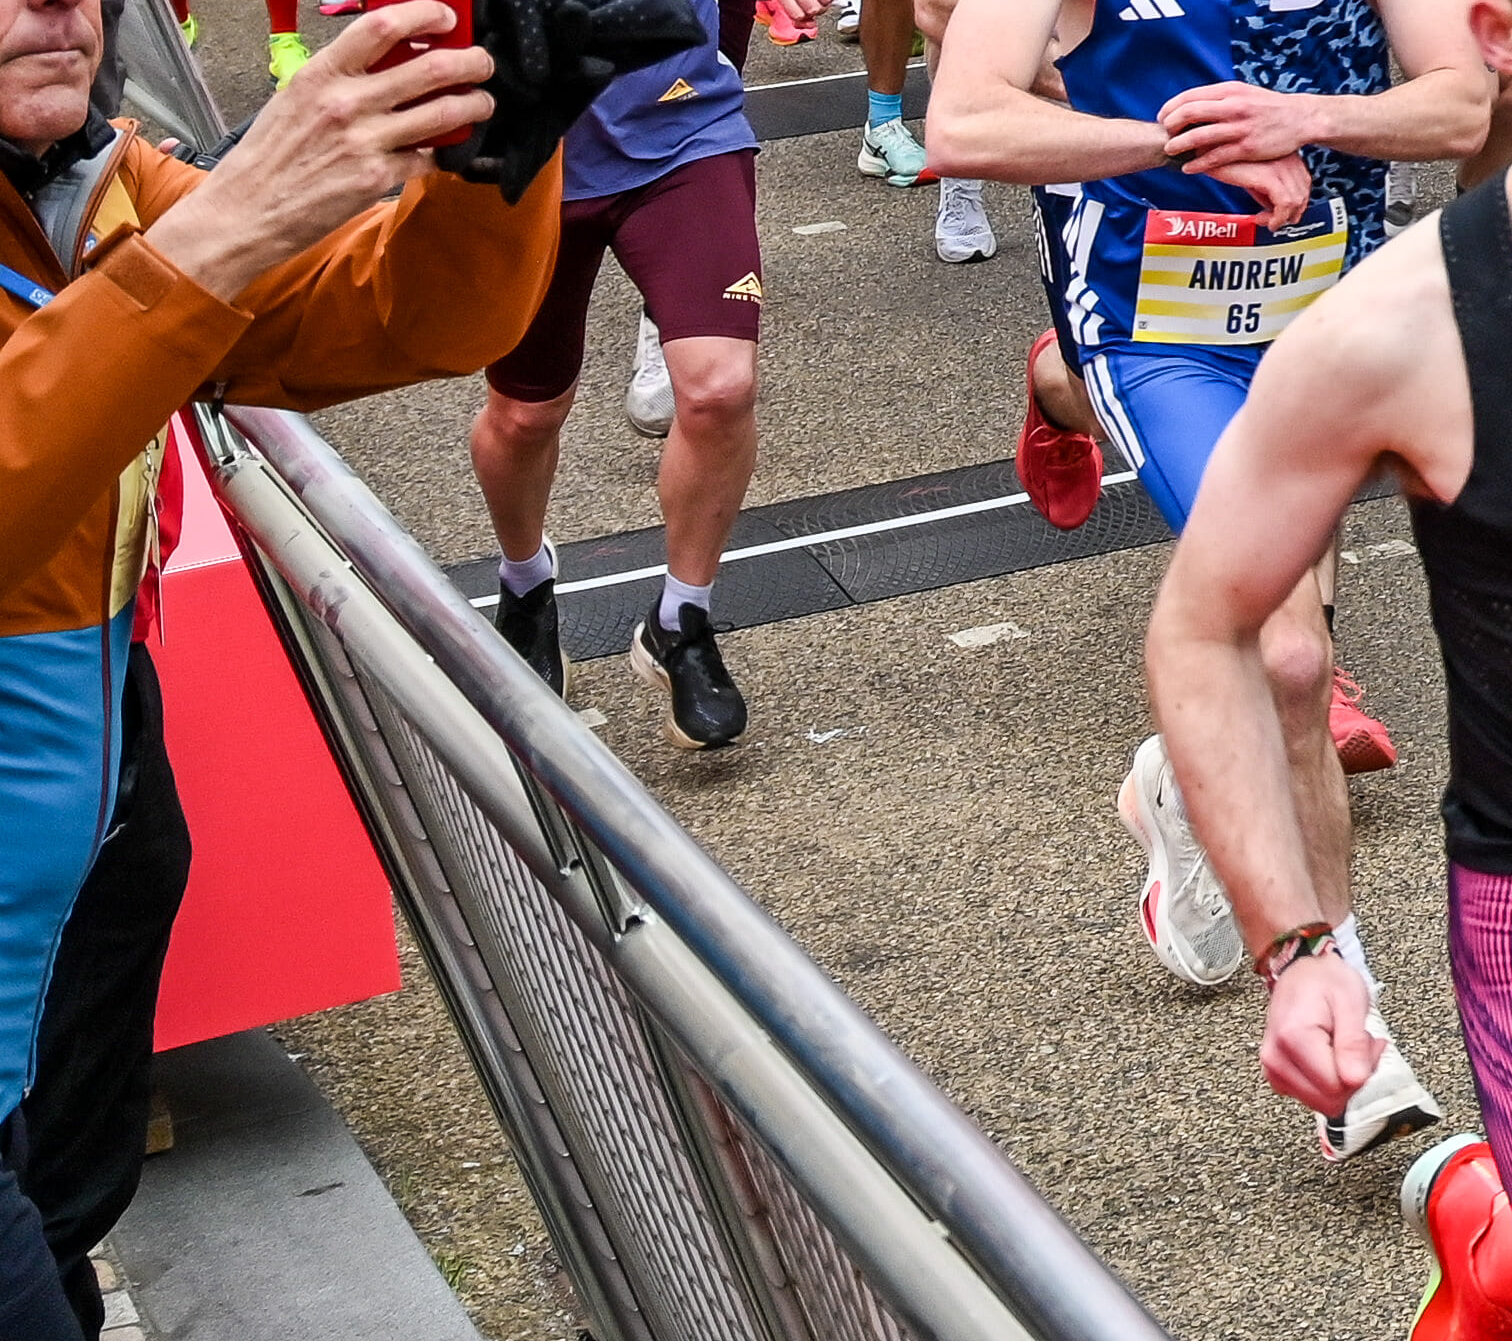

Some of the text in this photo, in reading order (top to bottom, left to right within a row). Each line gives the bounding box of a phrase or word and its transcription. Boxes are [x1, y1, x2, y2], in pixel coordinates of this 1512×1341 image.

[1183, 221, 1238, 240] AJBell
[1188, 254, 1305, 293] ANDREW
[1225, 303, 1263, 335] 65
